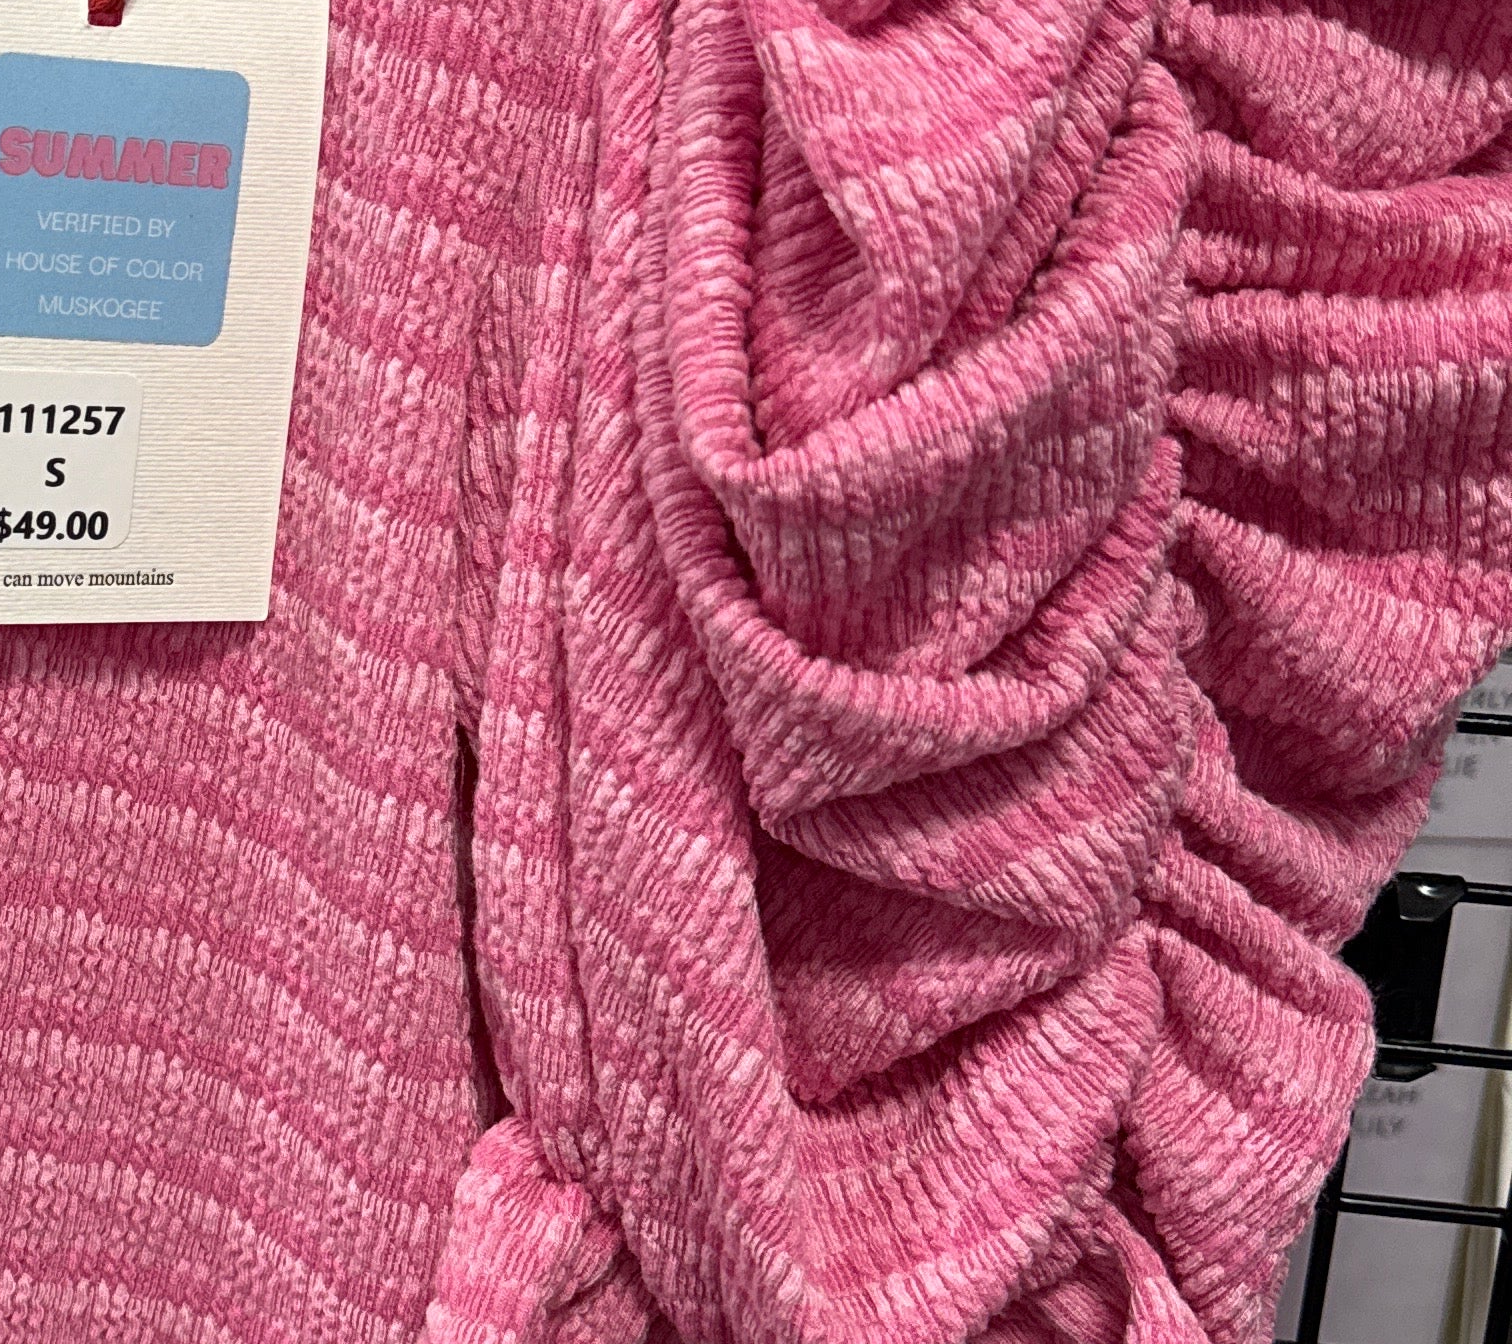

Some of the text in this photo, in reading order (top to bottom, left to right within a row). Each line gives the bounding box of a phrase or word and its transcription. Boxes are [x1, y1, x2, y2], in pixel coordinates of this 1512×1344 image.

[37, 210, 176, 239] VERIFIED BY
[5, 251, 204, 281] HOUSE OF COLOR
[37, 294, 163, 320] MUSKOGEE
[44, 457, 67, 488] S
[3, 574, 33, 587] can
[38, 573, 85, 587] move
[88, 568, 175, 587] mountains
